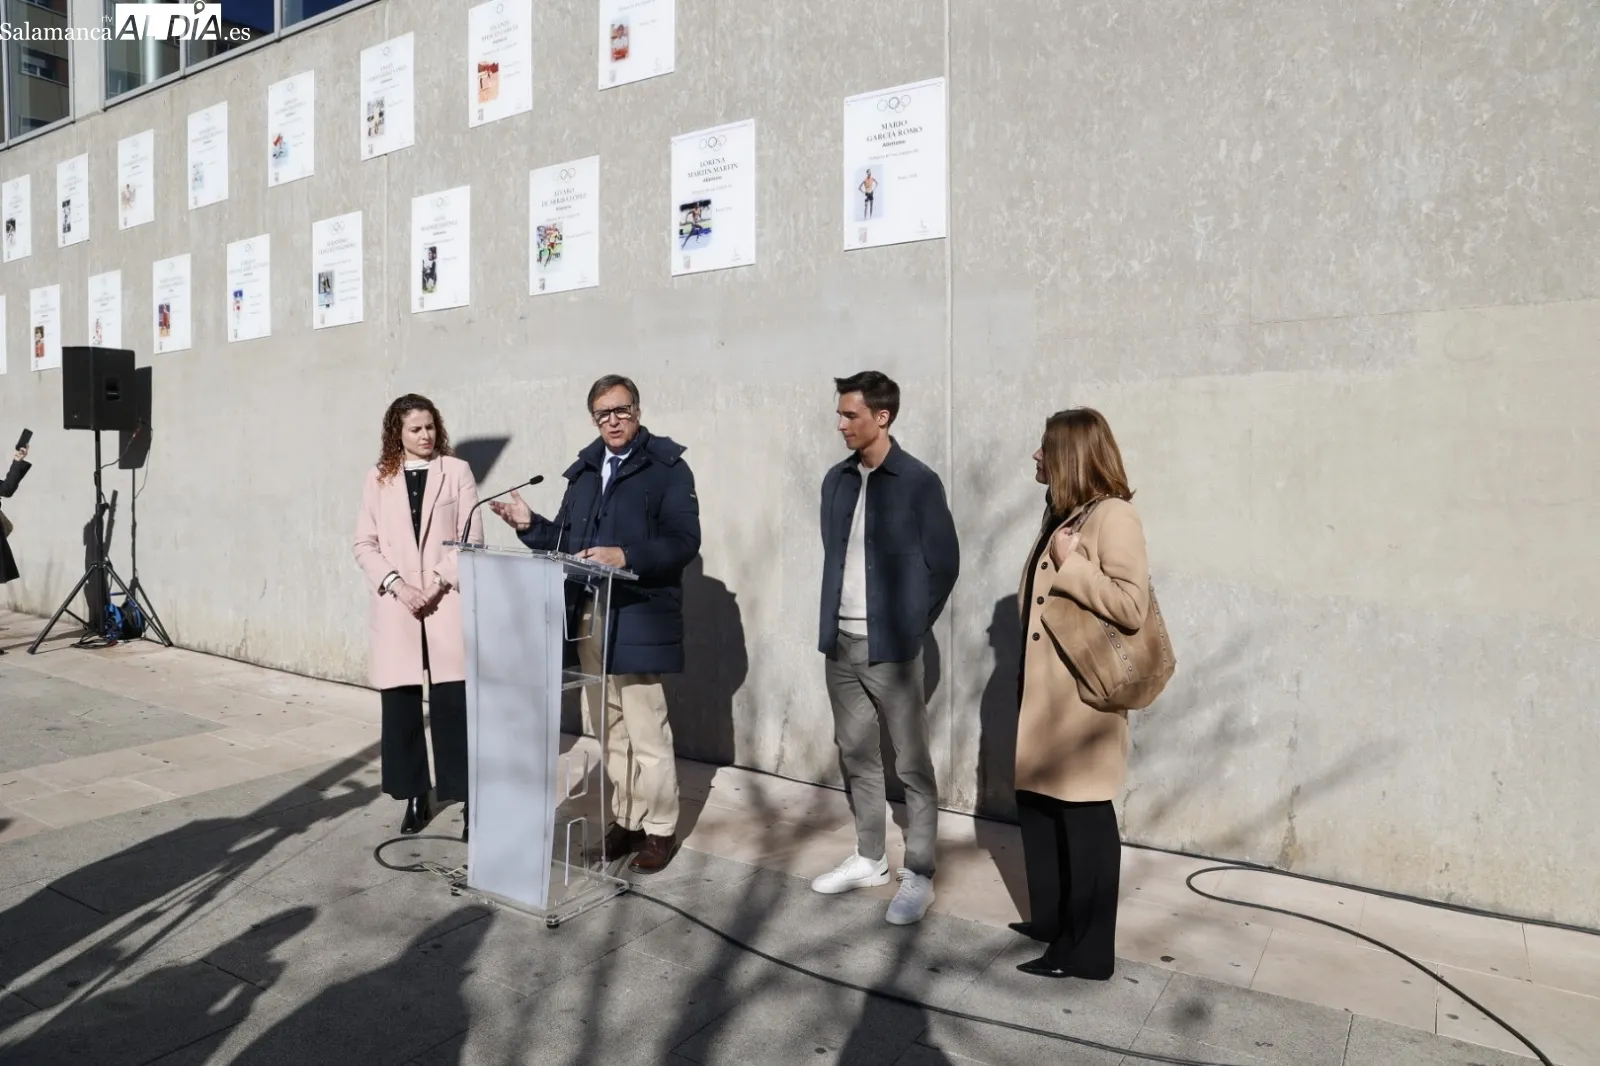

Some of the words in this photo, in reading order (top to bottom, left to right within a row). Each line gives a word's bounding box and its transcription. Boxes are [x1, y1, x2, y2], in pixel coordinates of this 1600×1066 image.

[881, 120, 908, 130] MARIO
[898, 126, 923, 137] ROMO
[699, 157, 726, 168] LORENA
